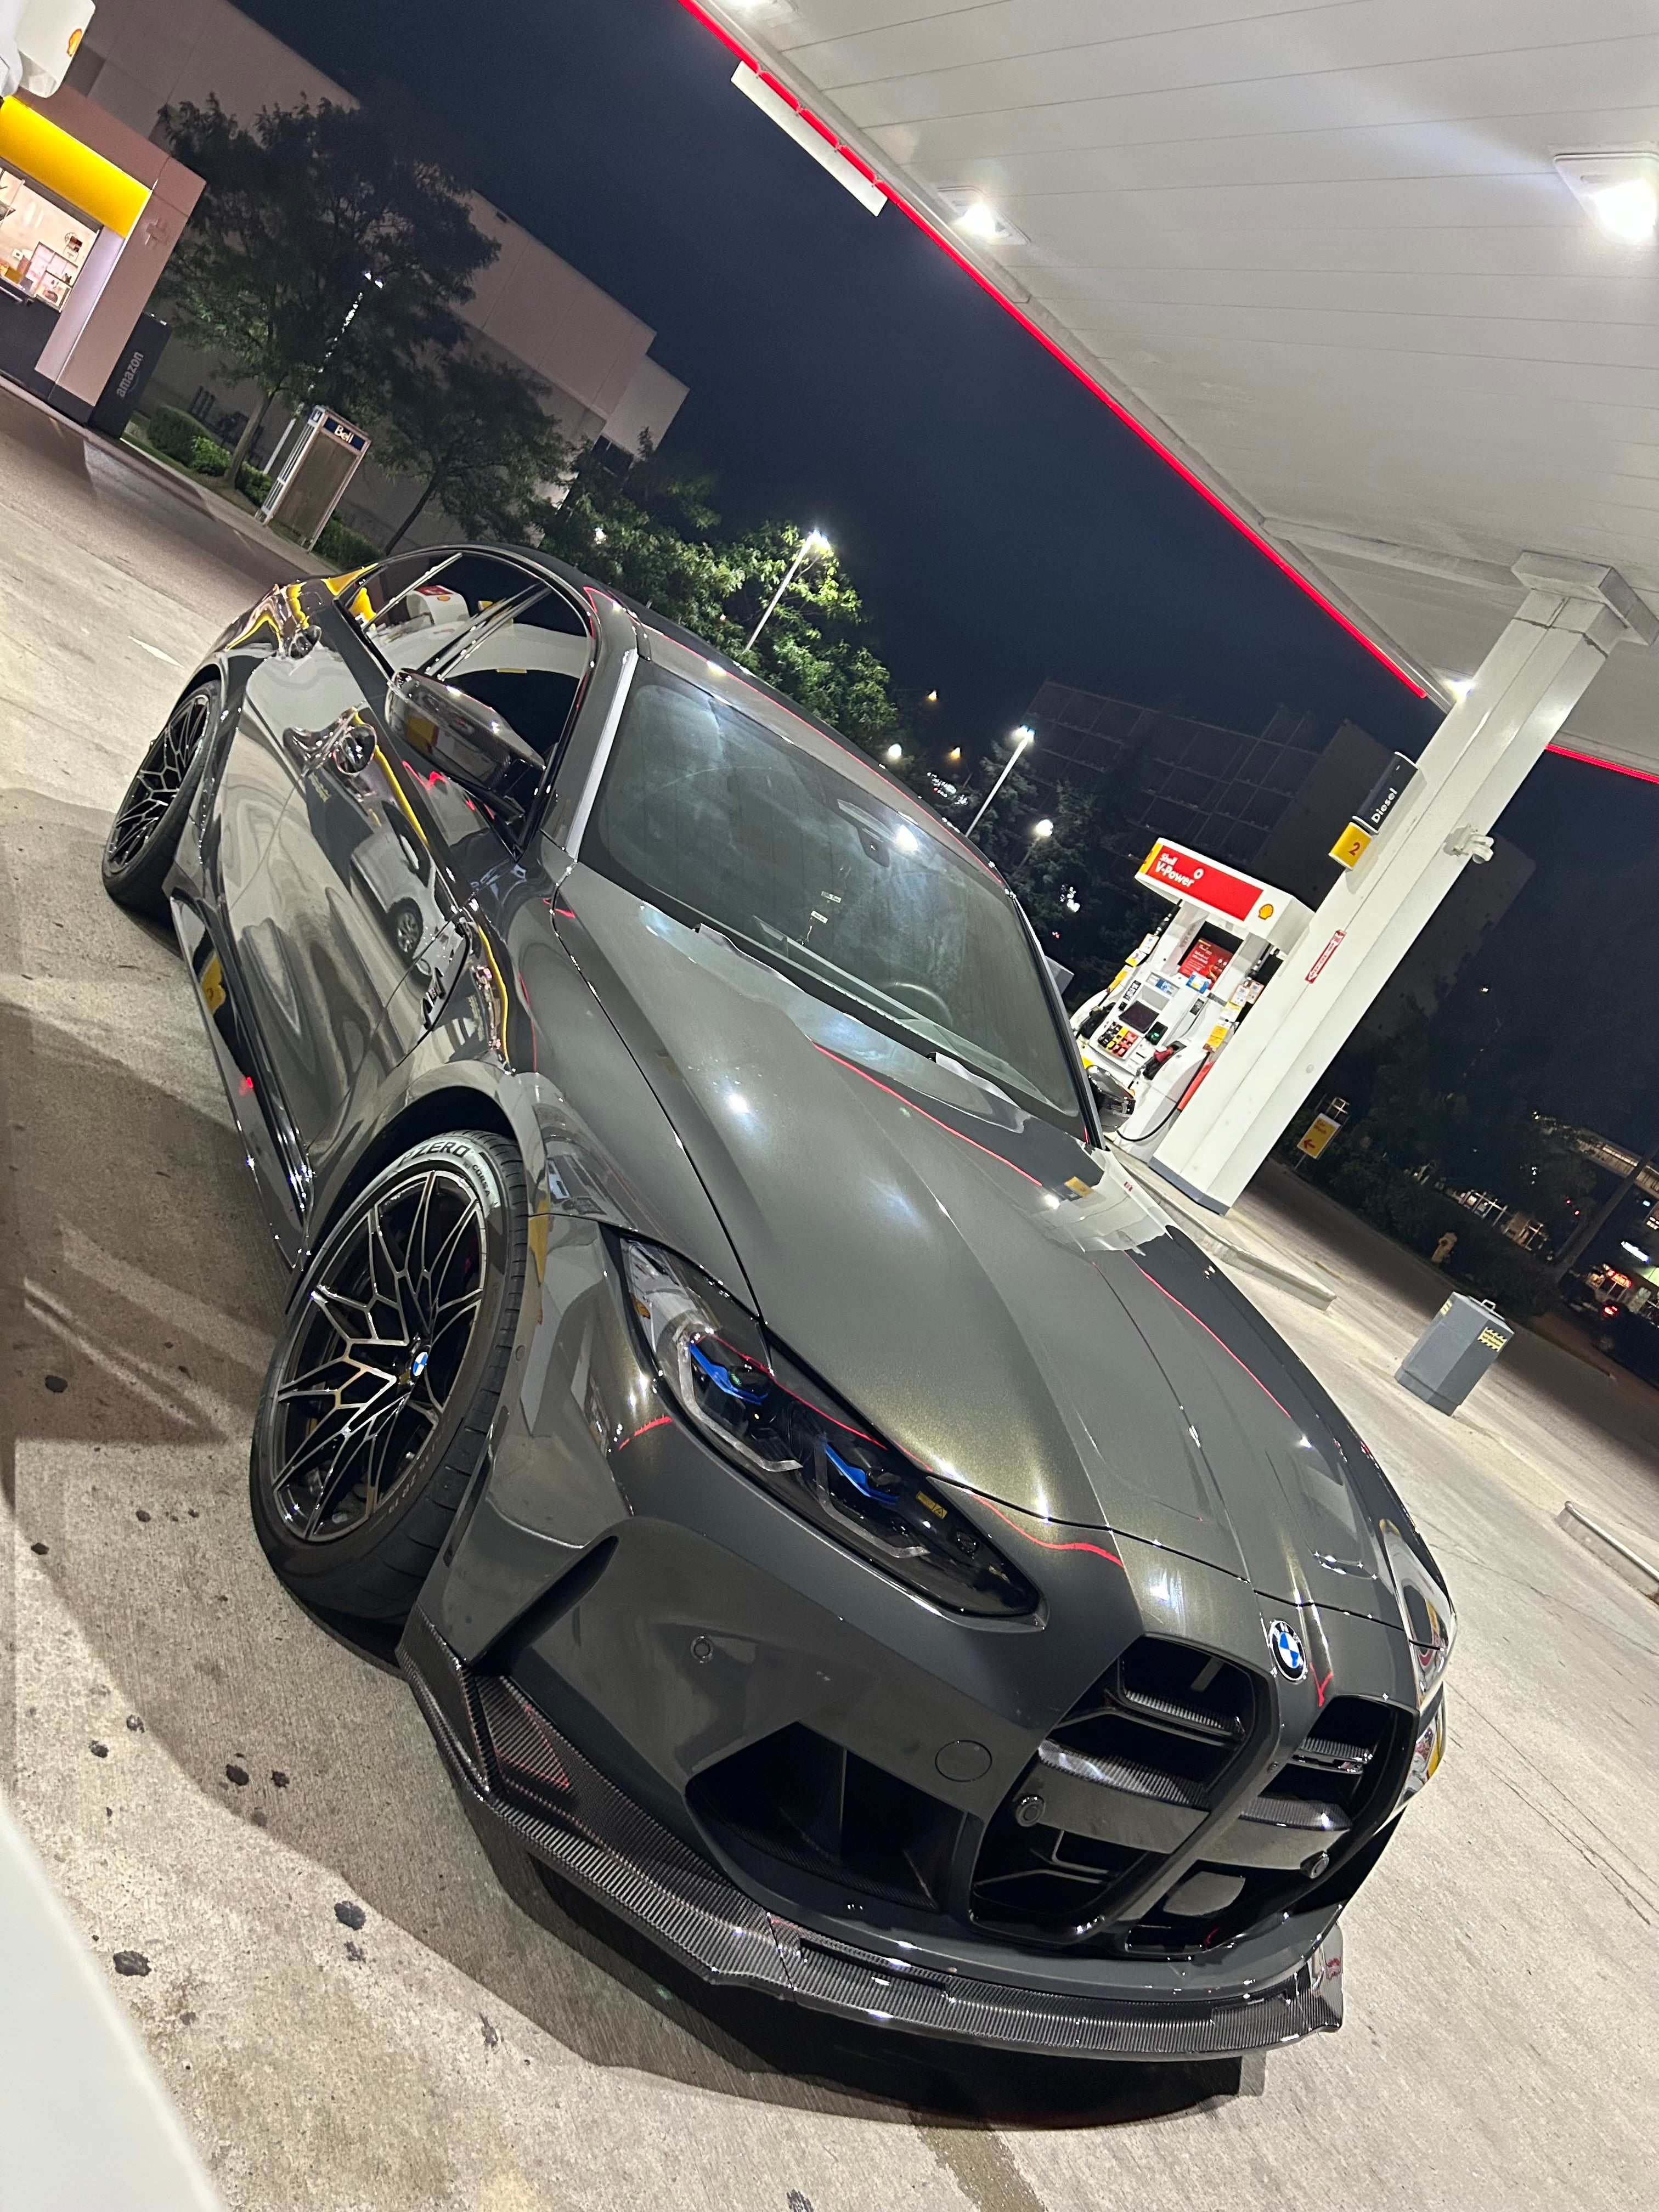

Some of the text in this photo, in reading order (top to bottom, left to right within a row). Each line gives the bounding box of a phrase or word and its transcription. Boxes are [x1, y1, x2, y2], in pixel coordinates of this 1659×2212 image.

[116, 352, 144, 398] amazon
[334, 425, 354, 443] Bell
[1371, 787, 1397, 823] Diesel
[1160, 853, 1178, 866] Shell
[1348, 842, 1361, 856] 2
[1155, 862, 1197, 887] V-Power
[472, 1165, 490, 1198] CORSA
